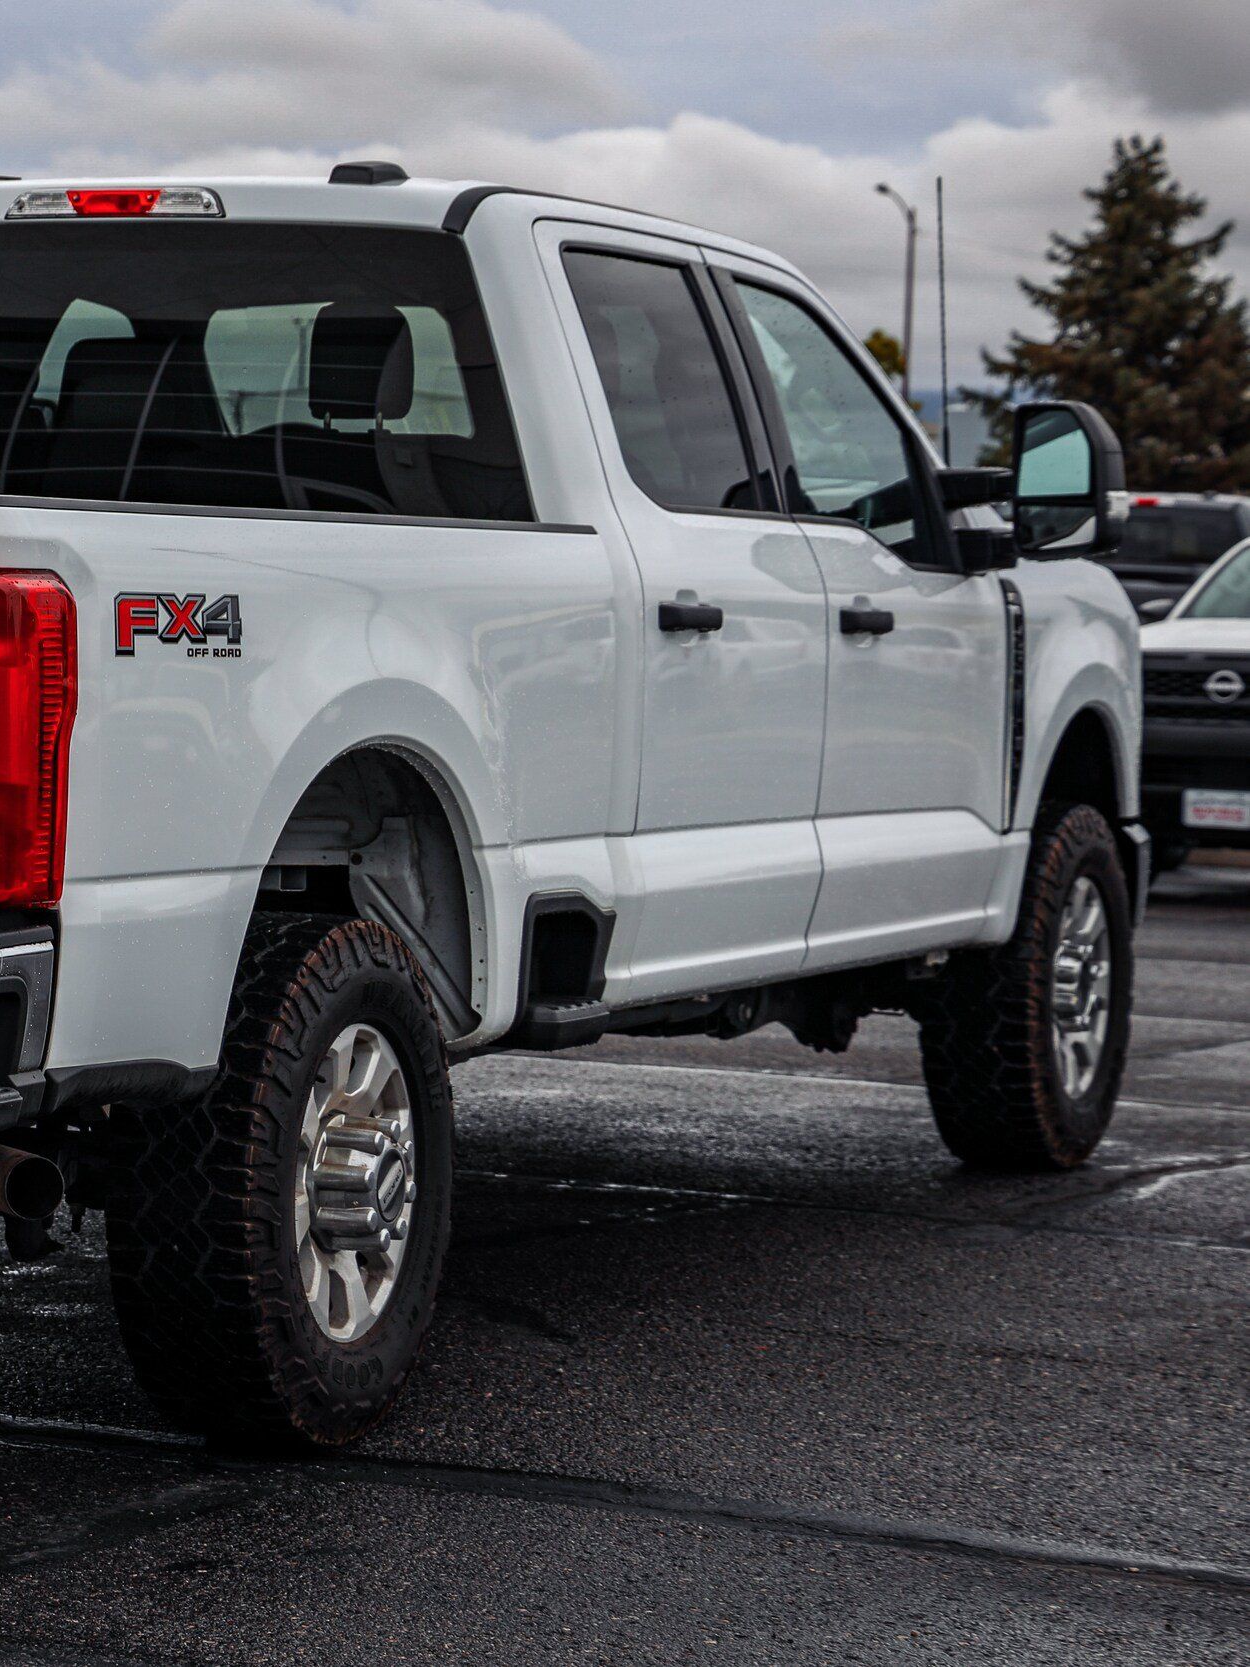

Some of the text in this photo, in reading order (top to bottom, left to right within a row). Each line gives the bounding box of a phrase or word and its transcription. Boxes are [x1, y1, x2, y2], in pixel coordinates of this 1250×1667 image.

[114, 591, 242, 657] FX4
[187, 648, 242, 657] OFF ROAD
